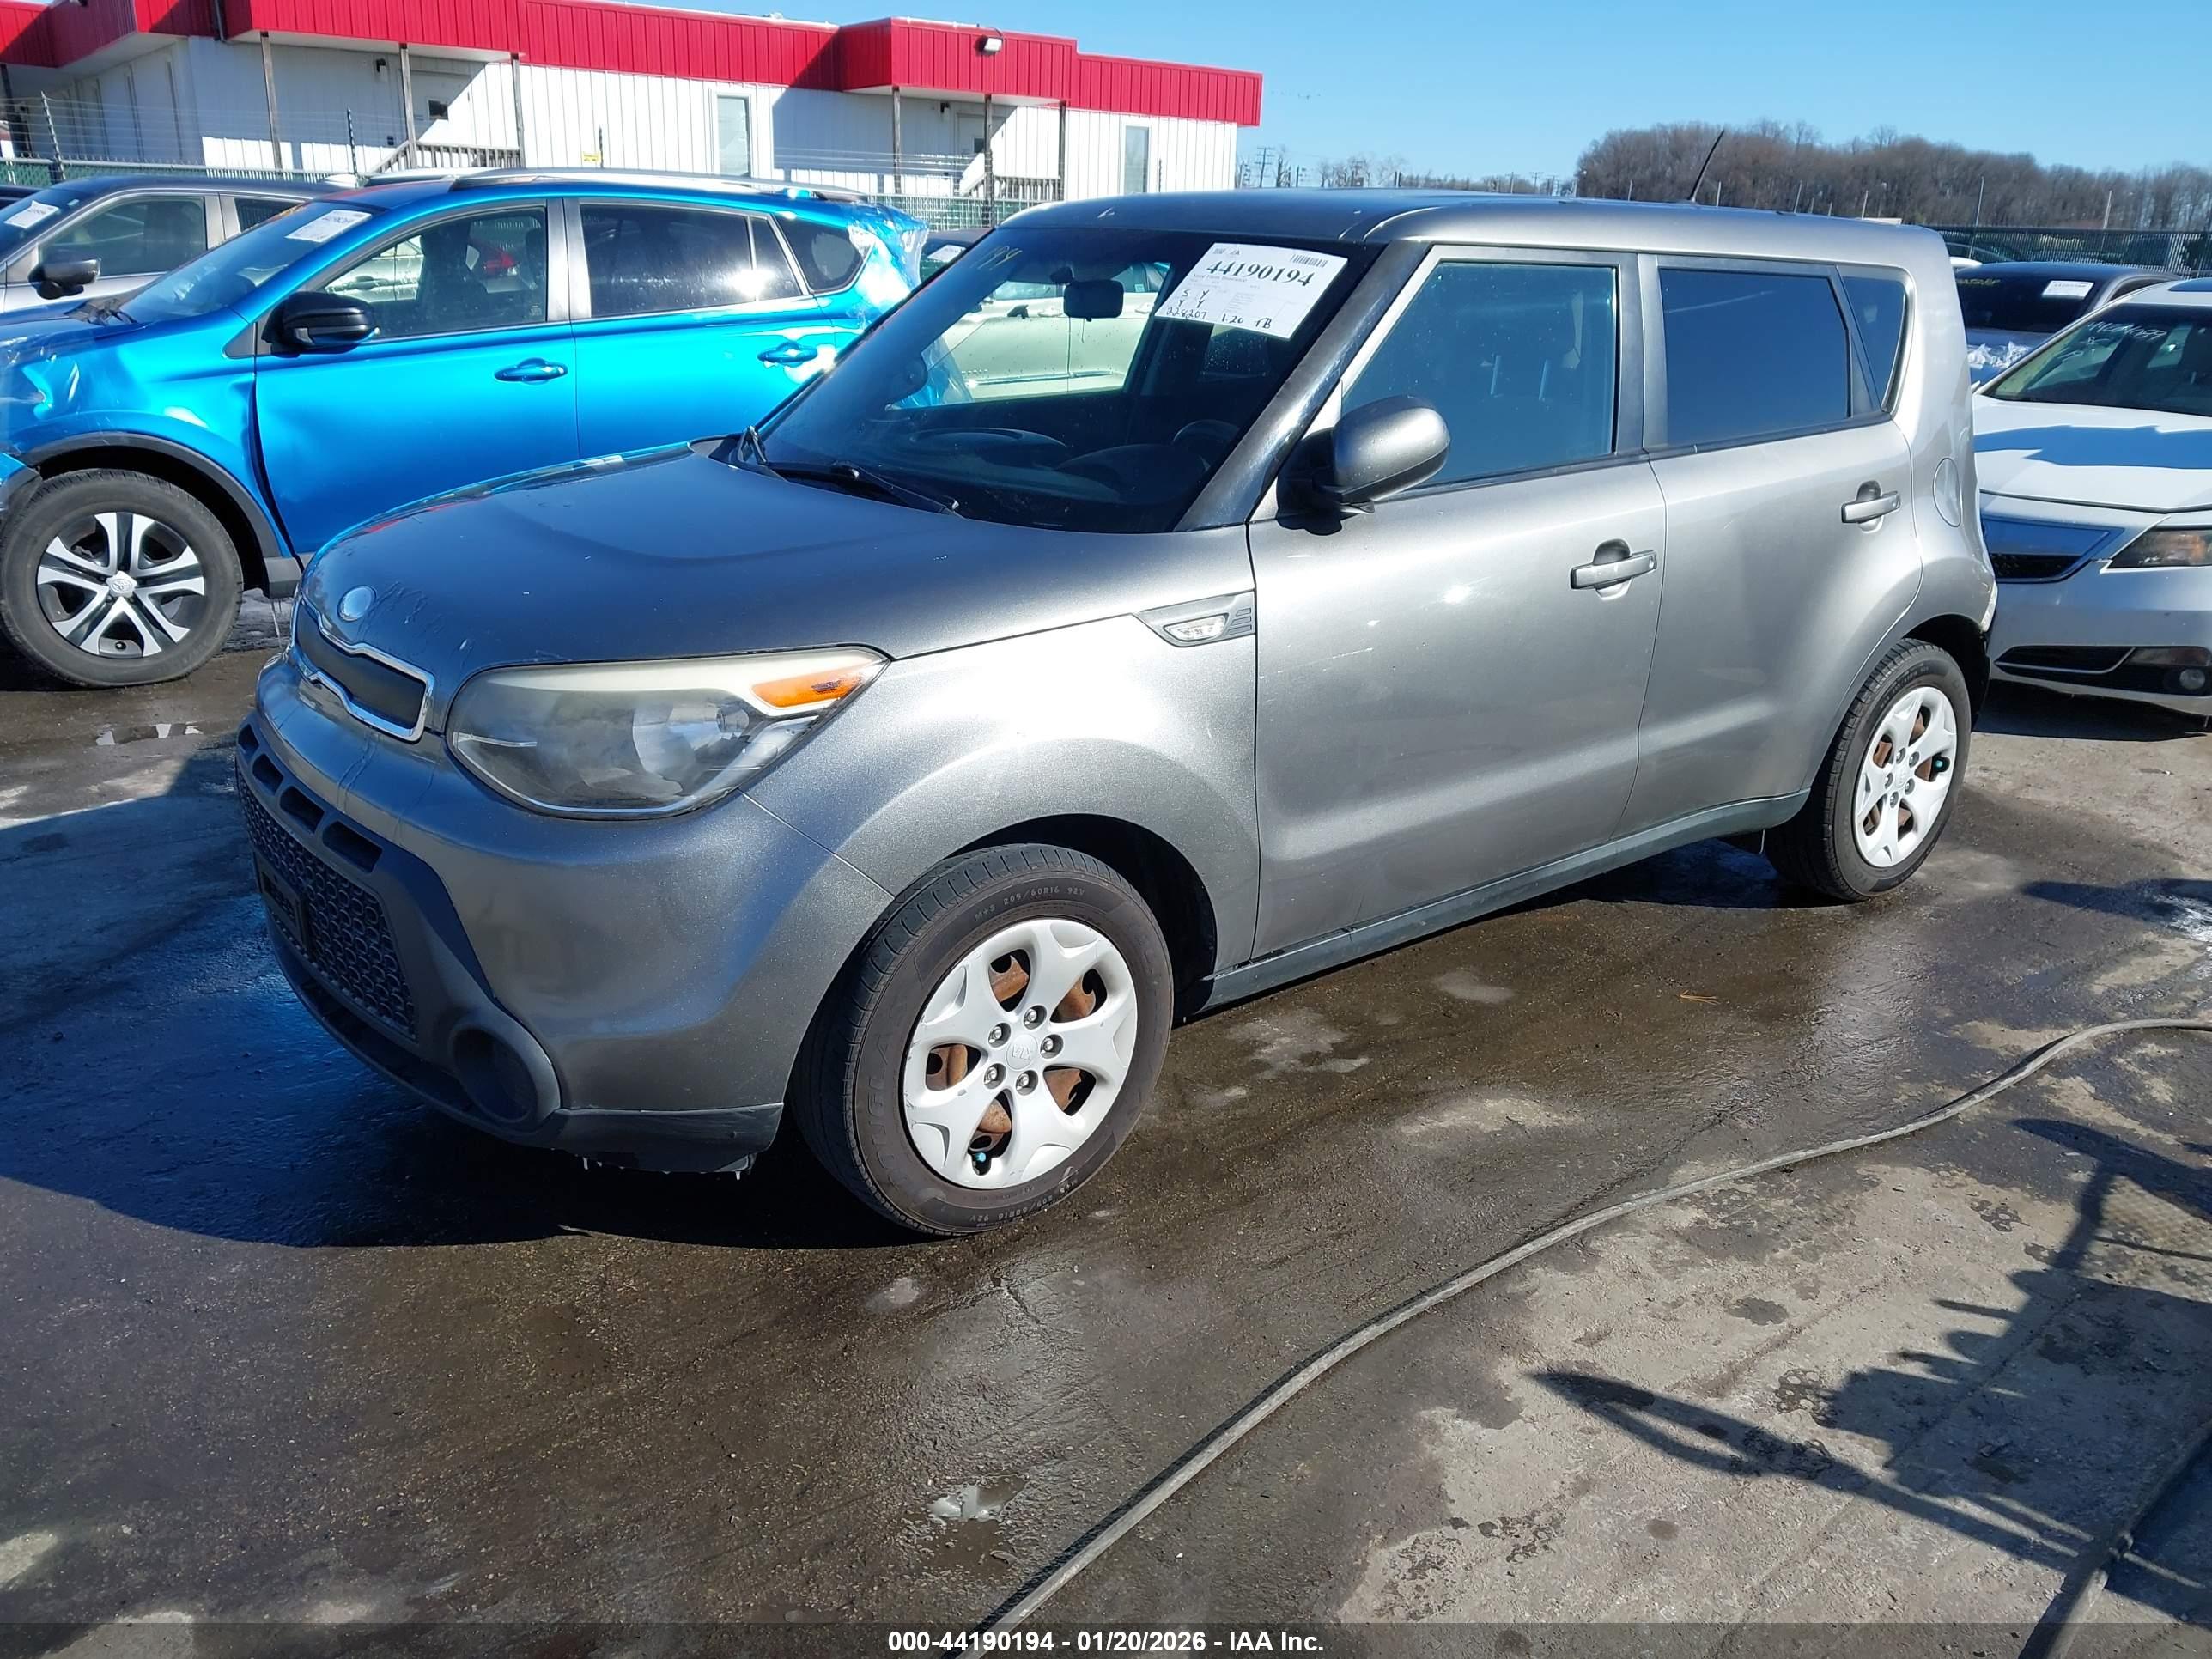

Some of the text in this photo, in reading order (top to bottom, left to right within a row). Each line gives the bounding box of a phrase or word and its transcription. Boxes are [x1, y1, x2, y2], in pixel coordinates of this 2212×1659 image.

[1206, 260, 1315, 286] 44190194
[1003, 885, 1060, 906] 205/60R16
[1067, 887, 1085, 896] 92V
